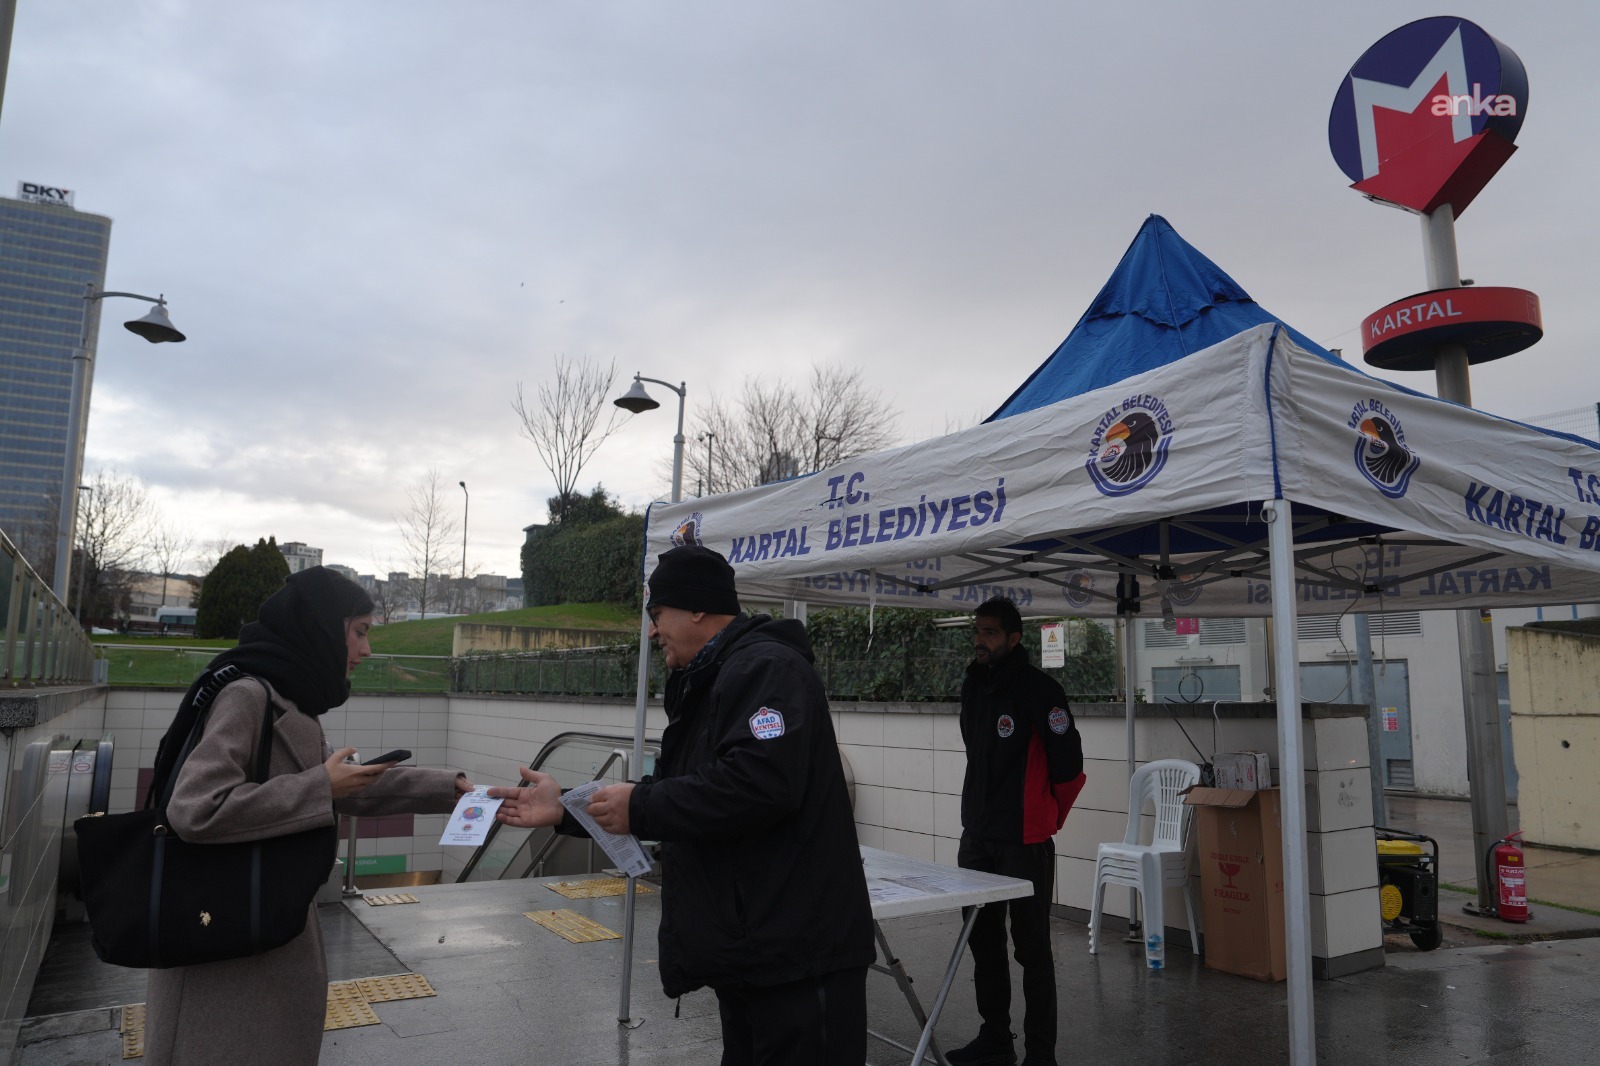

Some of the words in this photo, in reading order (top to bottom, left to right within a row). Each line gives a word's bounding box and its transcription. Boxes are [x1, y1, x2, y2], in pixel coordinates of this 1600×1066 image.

[23, 183, 69, 199] DKY
[1371, 299, 1462, 338] KARTAL
[1089, 407, 1121, 457] KARTAL
[1122, 394, 1176, 436] BELEDİYESİ
[827, 472, 870, 510] T.C.
[728, 525, 811, 564] KARTAL
[825, 478, 1007, 551] BELEDİYESİ
[1464, 482, 1568, 545] KARTAL
[757, 716, 776, 725] AFAD
[1213, 887, 1251, 901] FRAGILE
